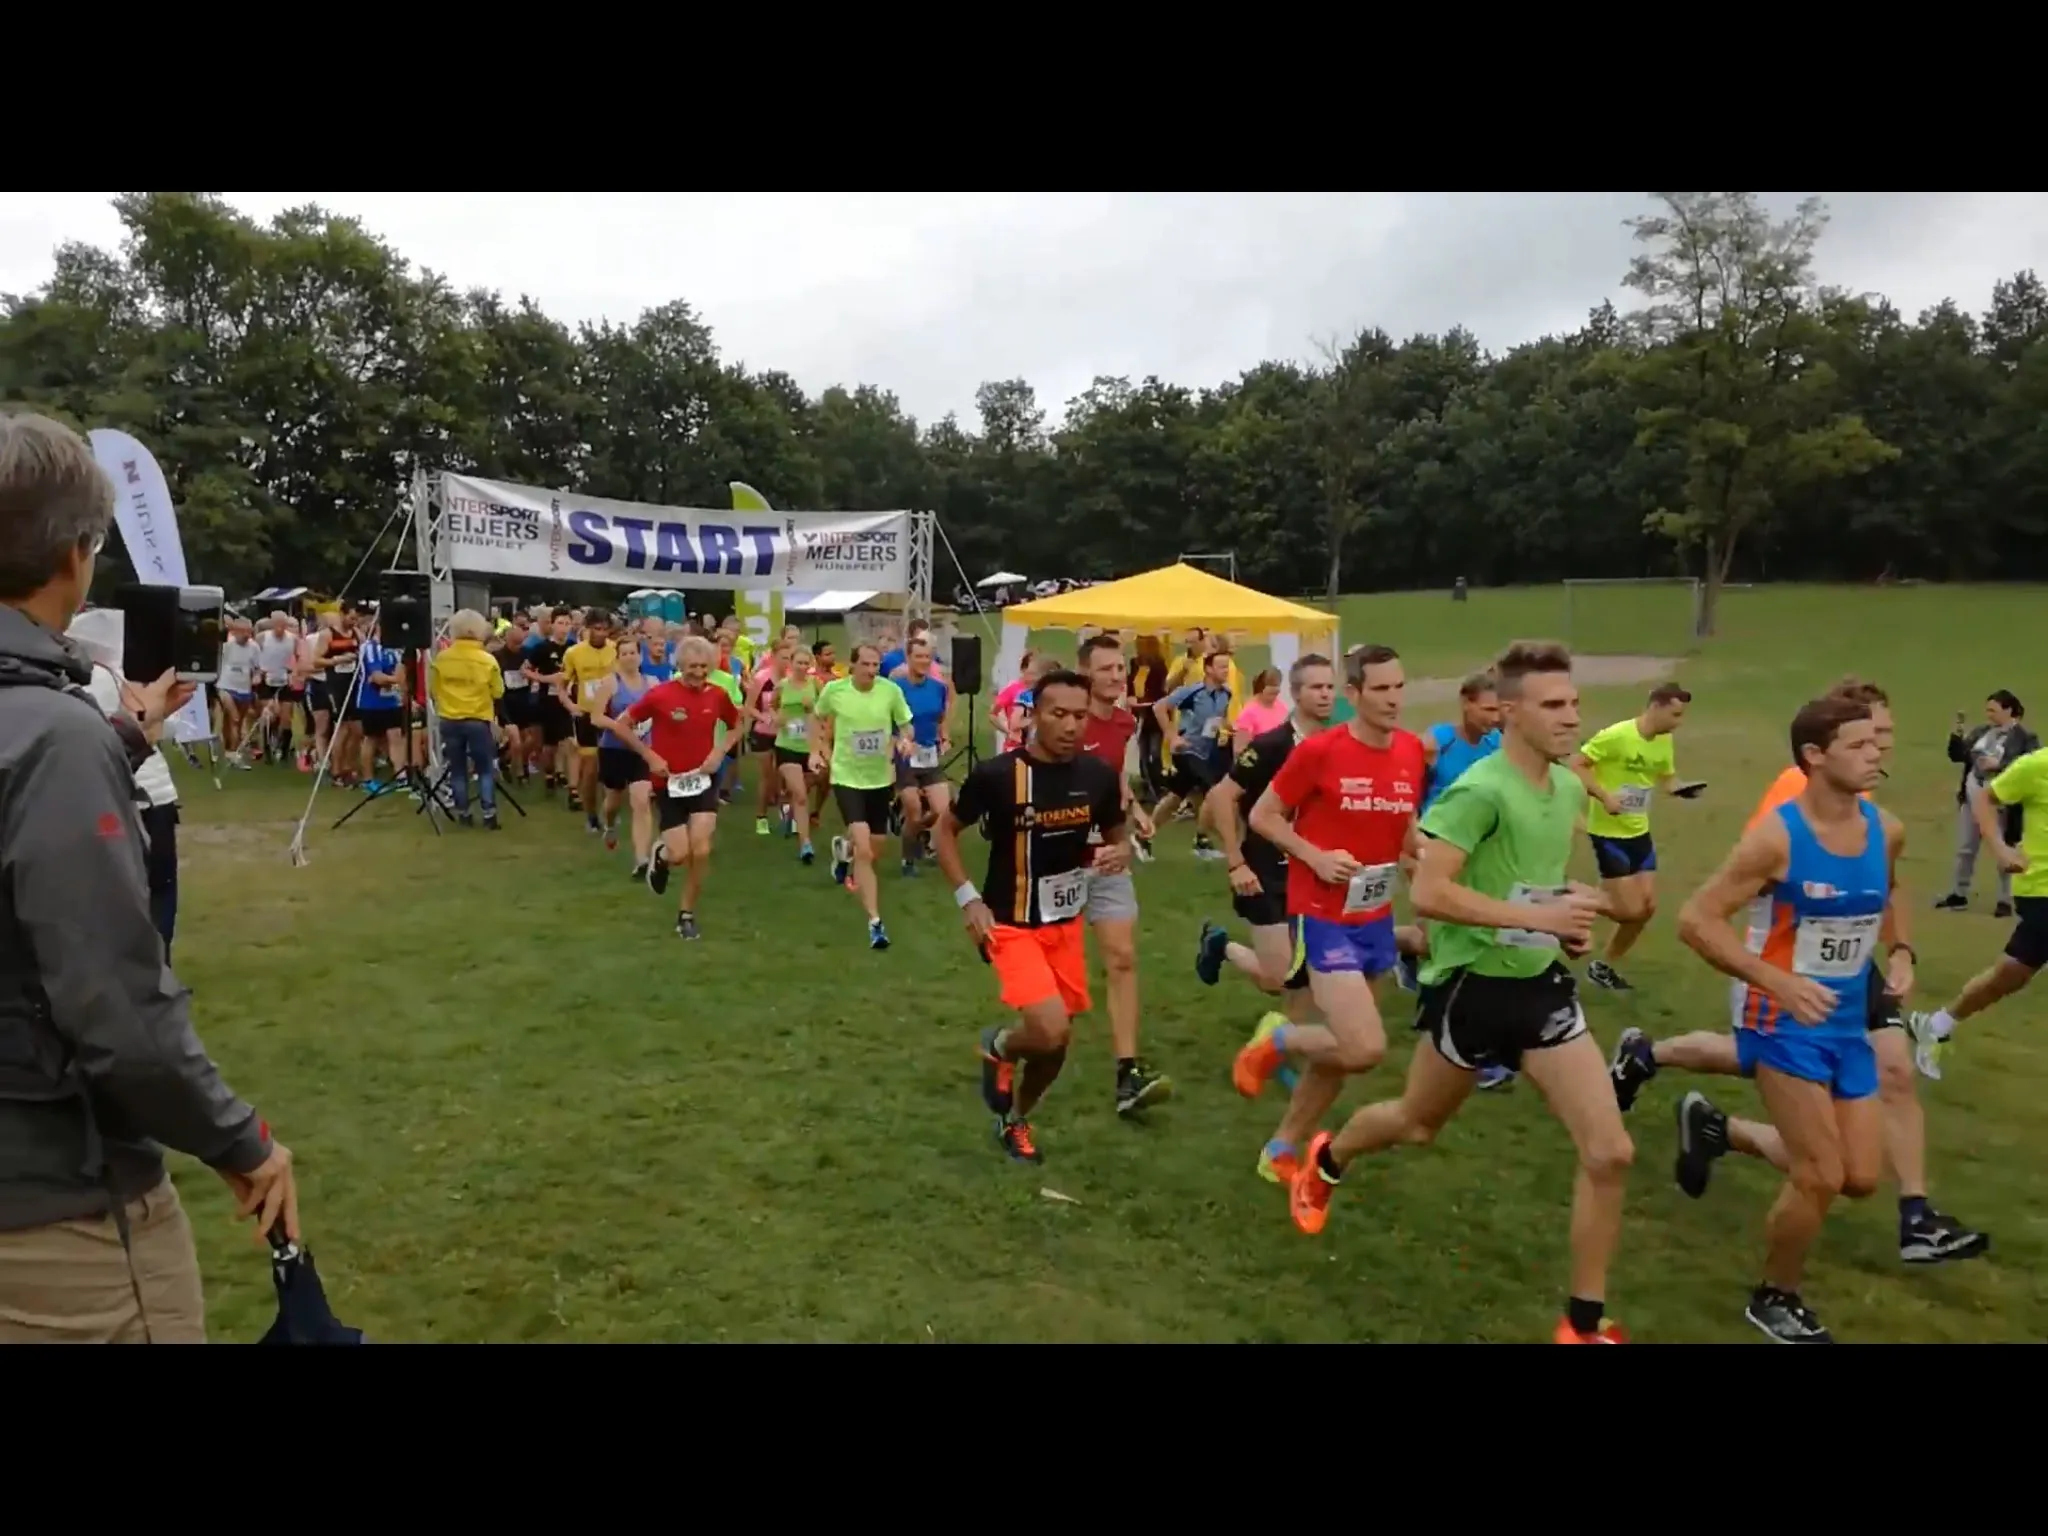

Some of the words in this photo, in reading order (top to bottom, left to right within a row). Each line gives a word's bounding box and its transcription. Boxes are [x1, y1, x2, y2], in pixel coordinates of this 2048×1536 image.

[446, 497, 540, 522] NTERSPORT
[440, 513, 539, 540] EIJERS
[820, 531, 898, 543] INTERSPORT
[568, 511, 780, 575] START
[805, 545, 898, 562] MEIJERS
